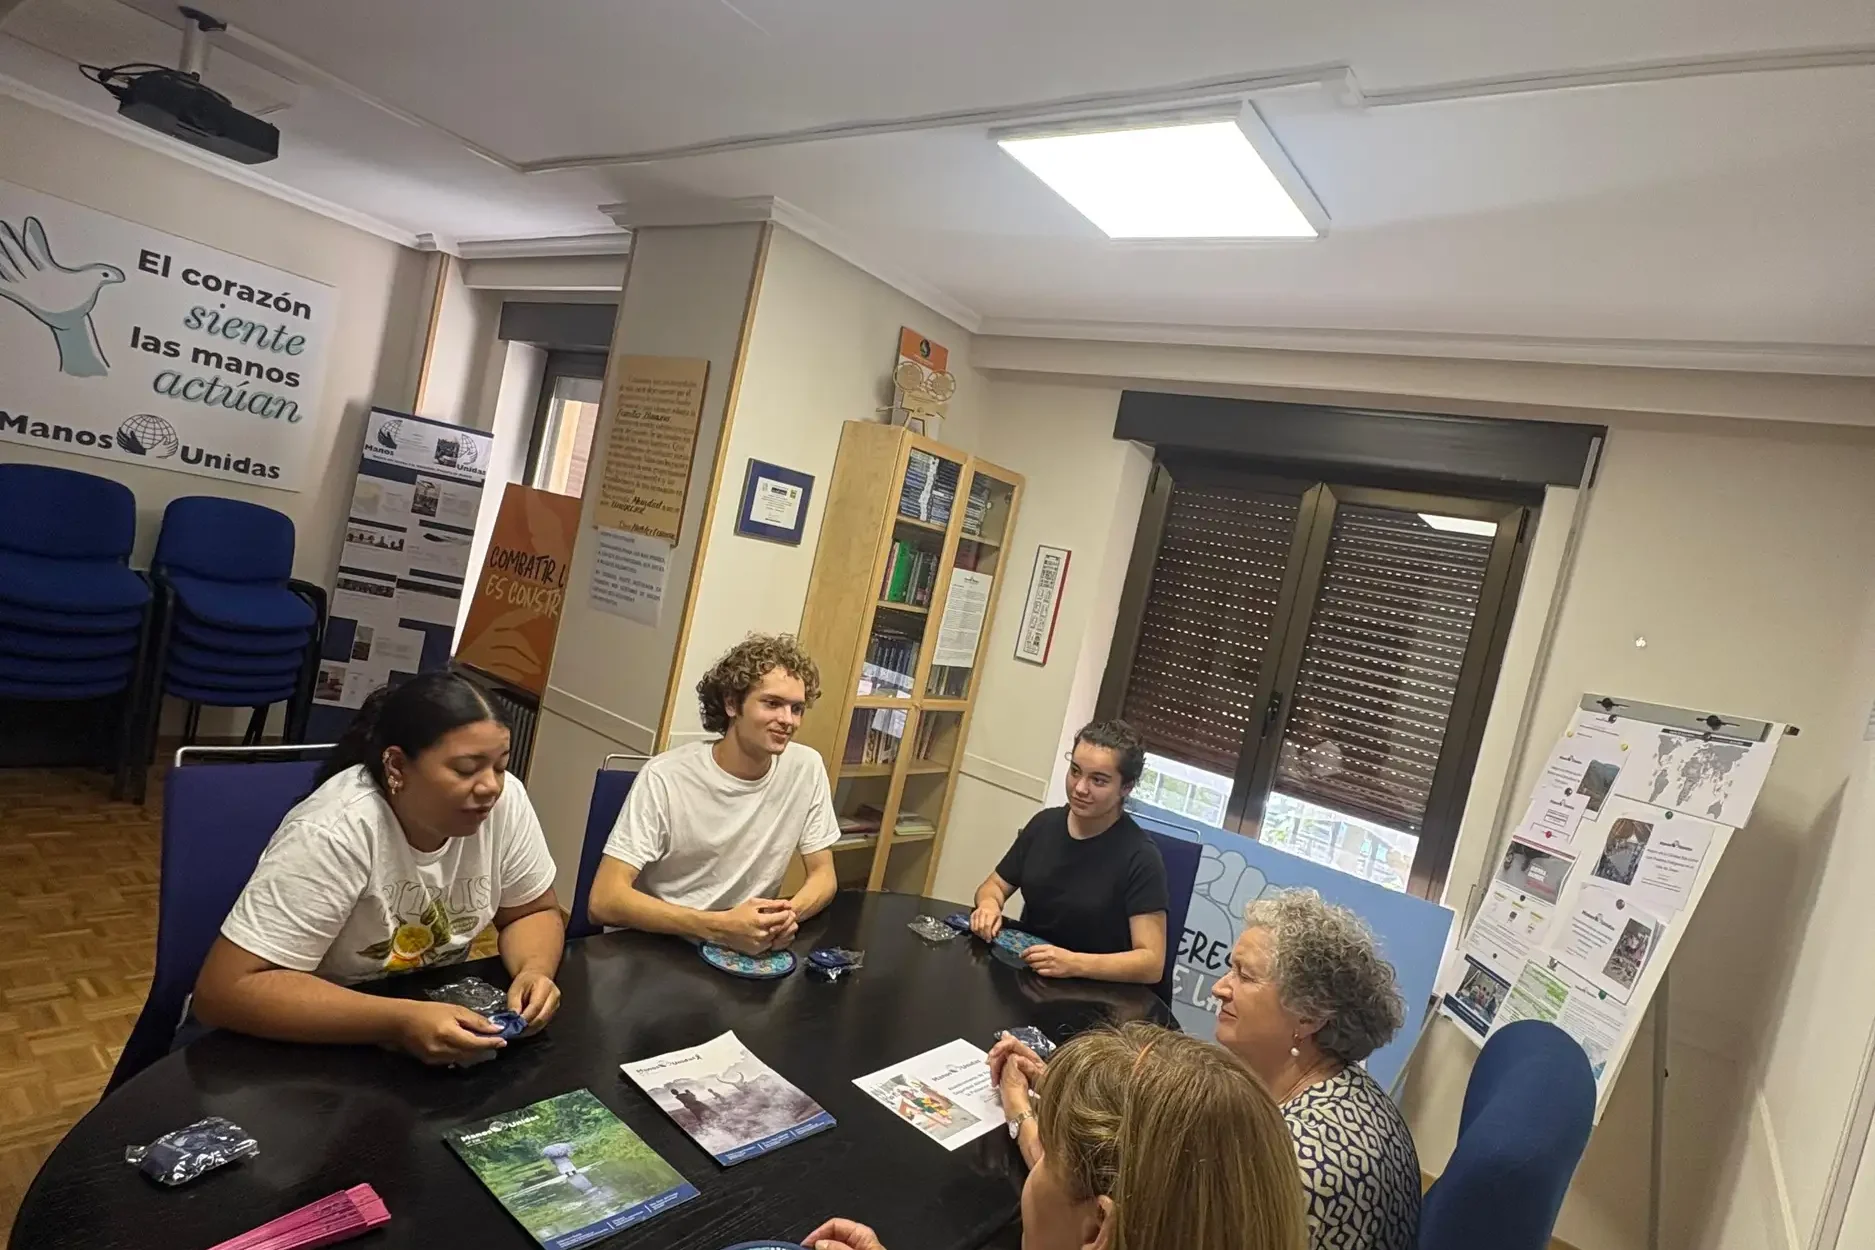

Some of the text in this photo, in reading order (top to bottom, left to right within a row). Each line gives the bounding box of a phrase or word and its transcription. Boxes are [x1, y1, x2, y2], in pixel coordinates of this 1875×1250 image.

[138, 249, 311, 320] El corazón
[184, 303, 306, 356] siente
[130, 326, 300, 387] las manos
[153, 369, 303, 424] actúan
[0, 410, 280, 479] Manos Unidas
[364, 444, 395, 456] Manos
[456, 464, 487, 476] Unidas
[485, 574, 508, 600] ES
[490, 546, 556, 585] COMBATIR
[460, 1115, 541, 1142] Manos Unidas
